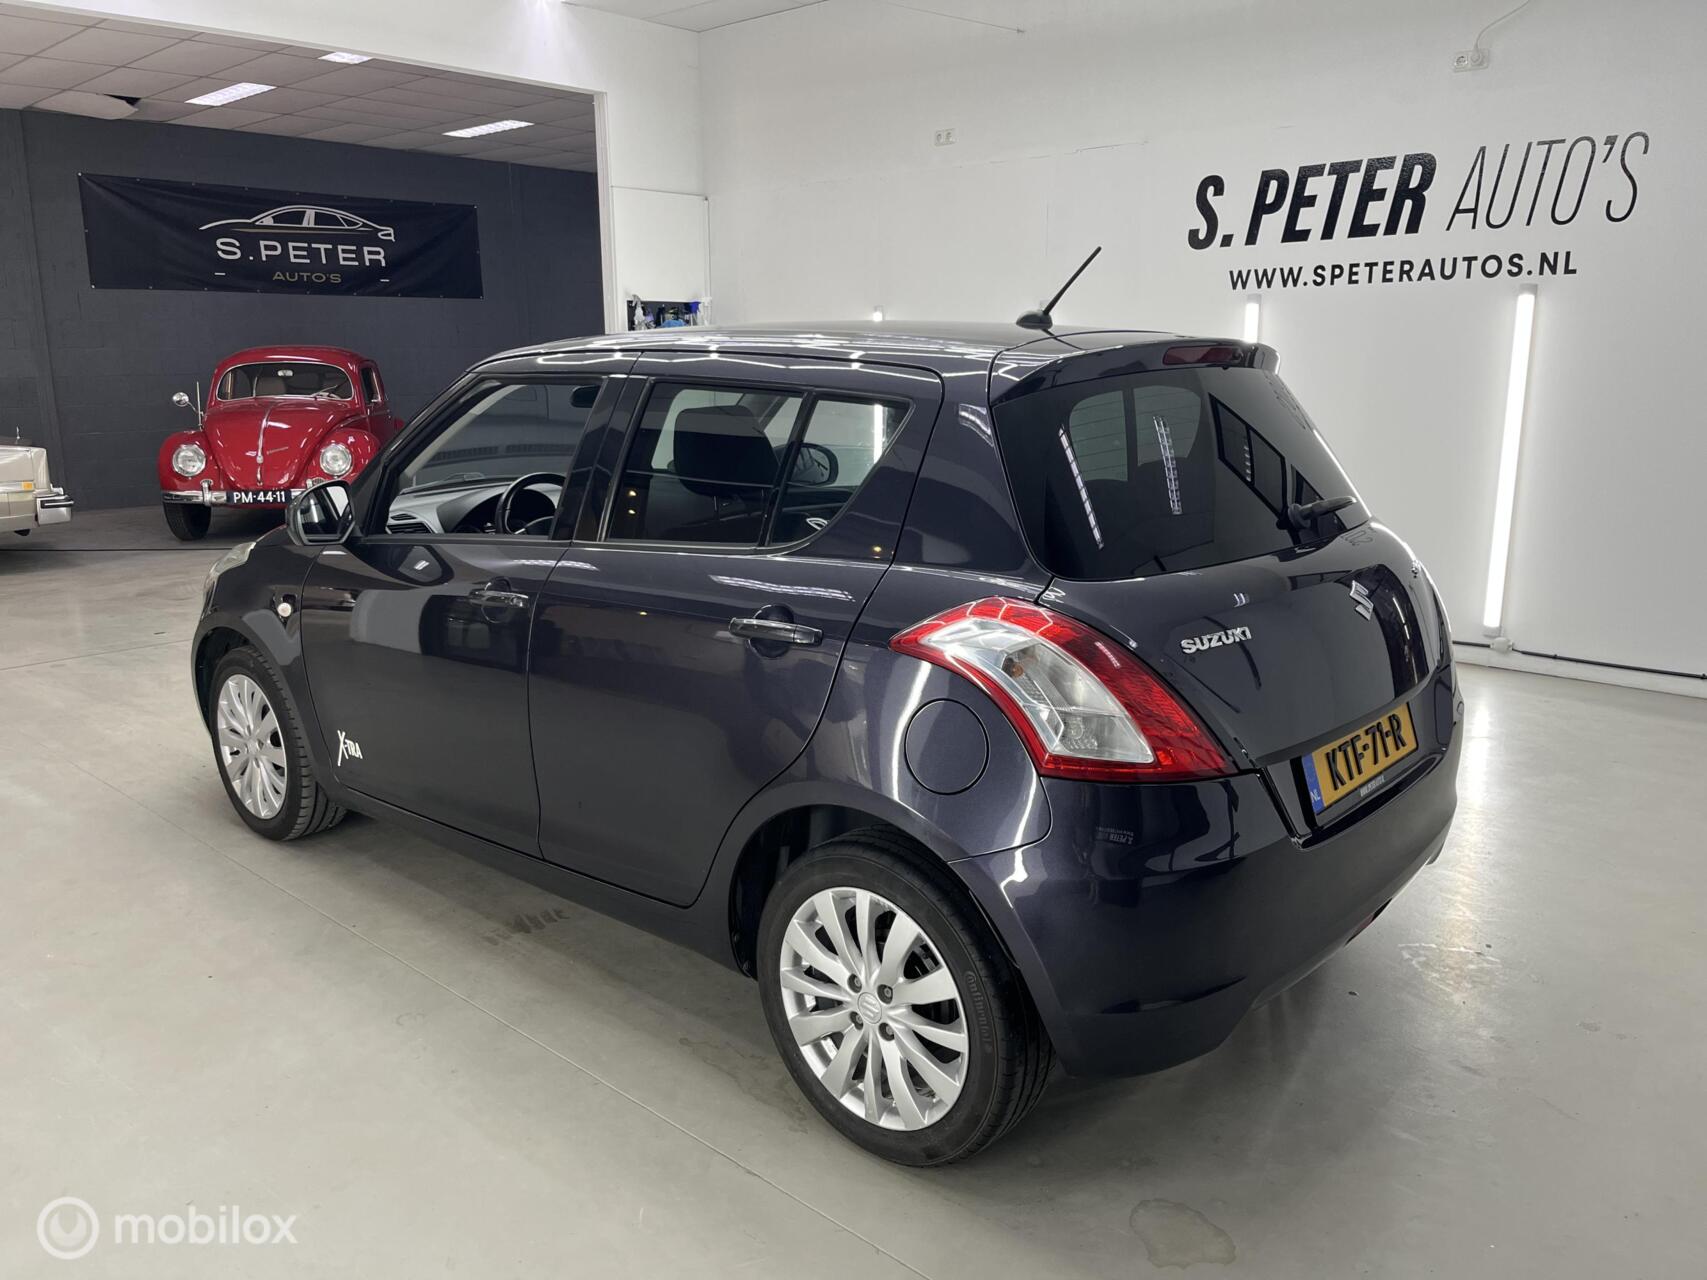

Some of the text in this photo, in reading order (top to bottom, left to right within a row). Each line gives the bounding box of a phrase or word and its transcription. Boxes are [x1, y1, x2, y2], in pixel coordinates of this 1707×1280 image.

[1244, 152, 1437, 246] PETER
[1446, 131, 1650, 232] AUTO'S
[272, 271, 342, 284] AUTO'S
[1229, 251, 1578, 291] WWW.SPETERAUTOS.NL
[233, 491, 286, 503] PM-44-11
[1180, 626, 1252, 654] SUZUKI
[1325, 713, 1408, 792] KTF-71-R
[1309, 788, 1321, 803] NL
